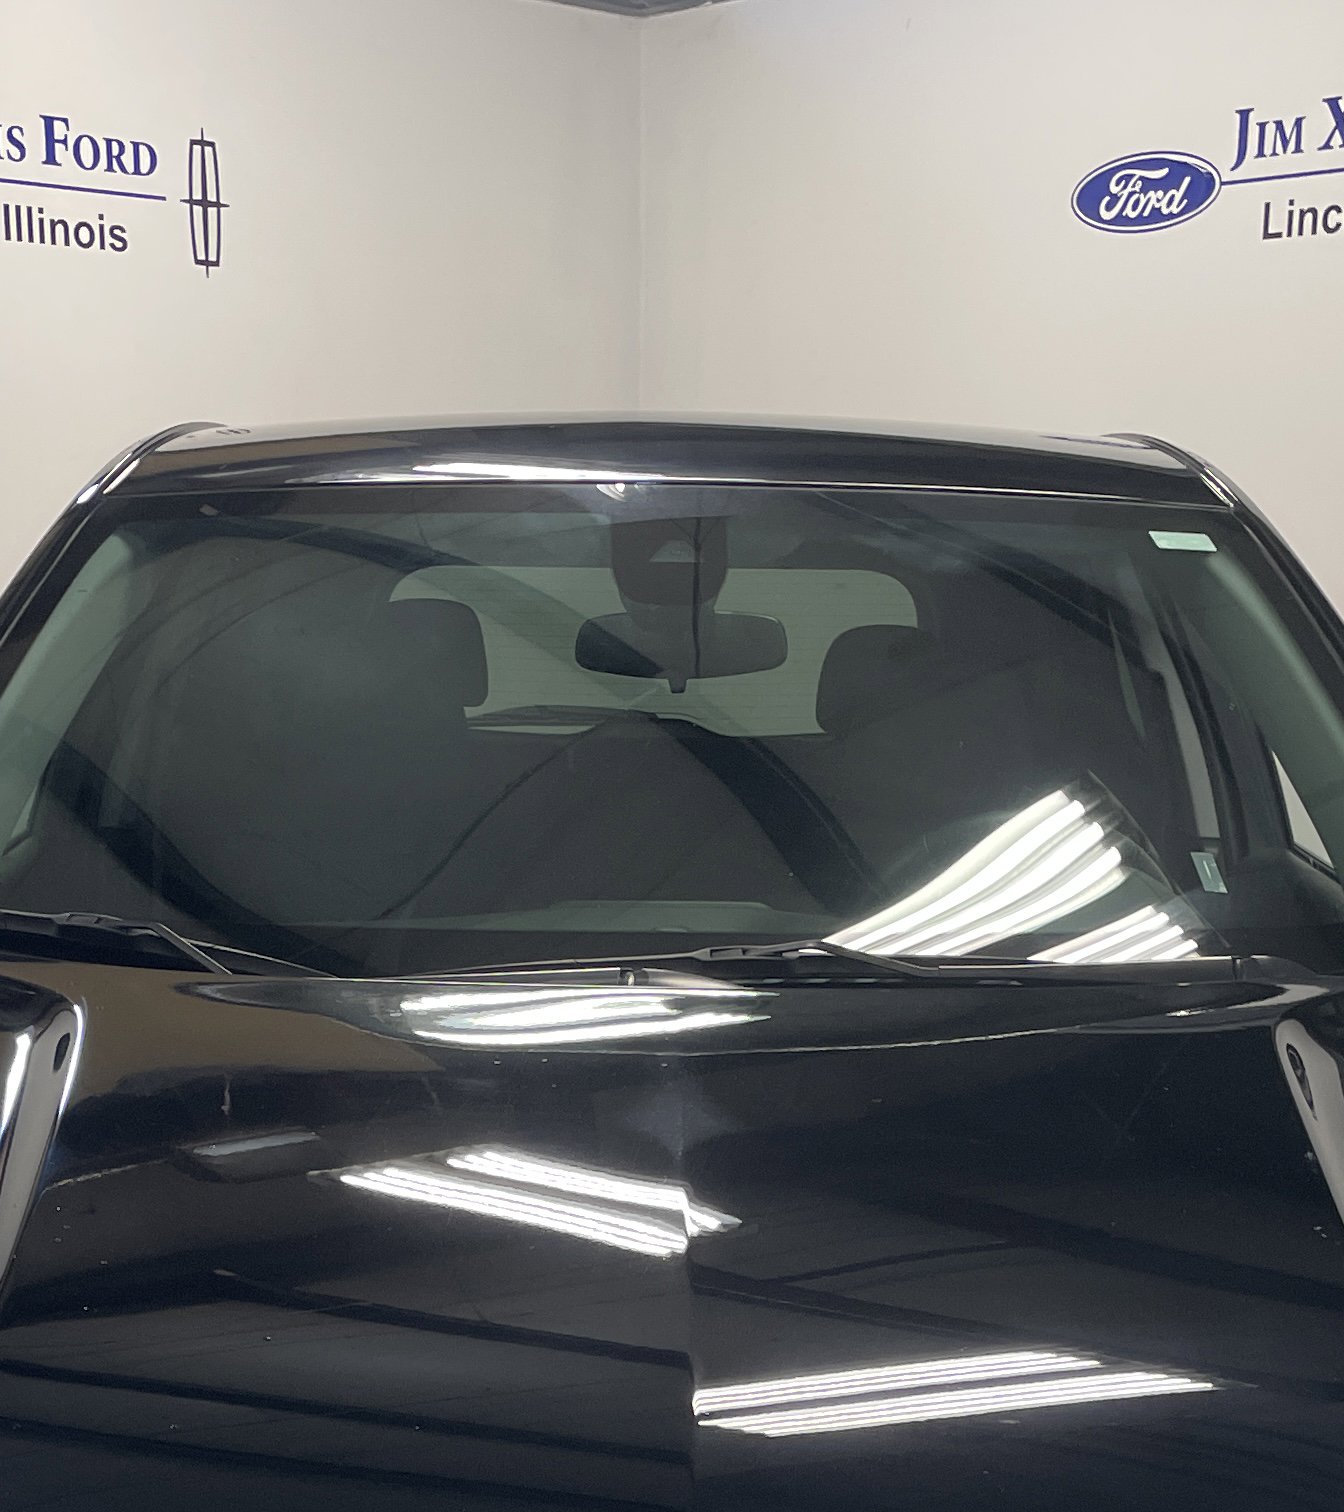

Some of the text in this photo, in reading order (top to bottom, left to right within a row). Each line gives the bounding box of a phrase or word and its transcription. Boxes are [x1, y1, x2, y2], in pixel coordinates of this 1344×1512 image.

[39, 114, 158, 177] FORD
[1230, 107, 1306, 172] JIM
[1100, 167, 1188, 218] Ford
[2, 202, 130, 254] Illinois
